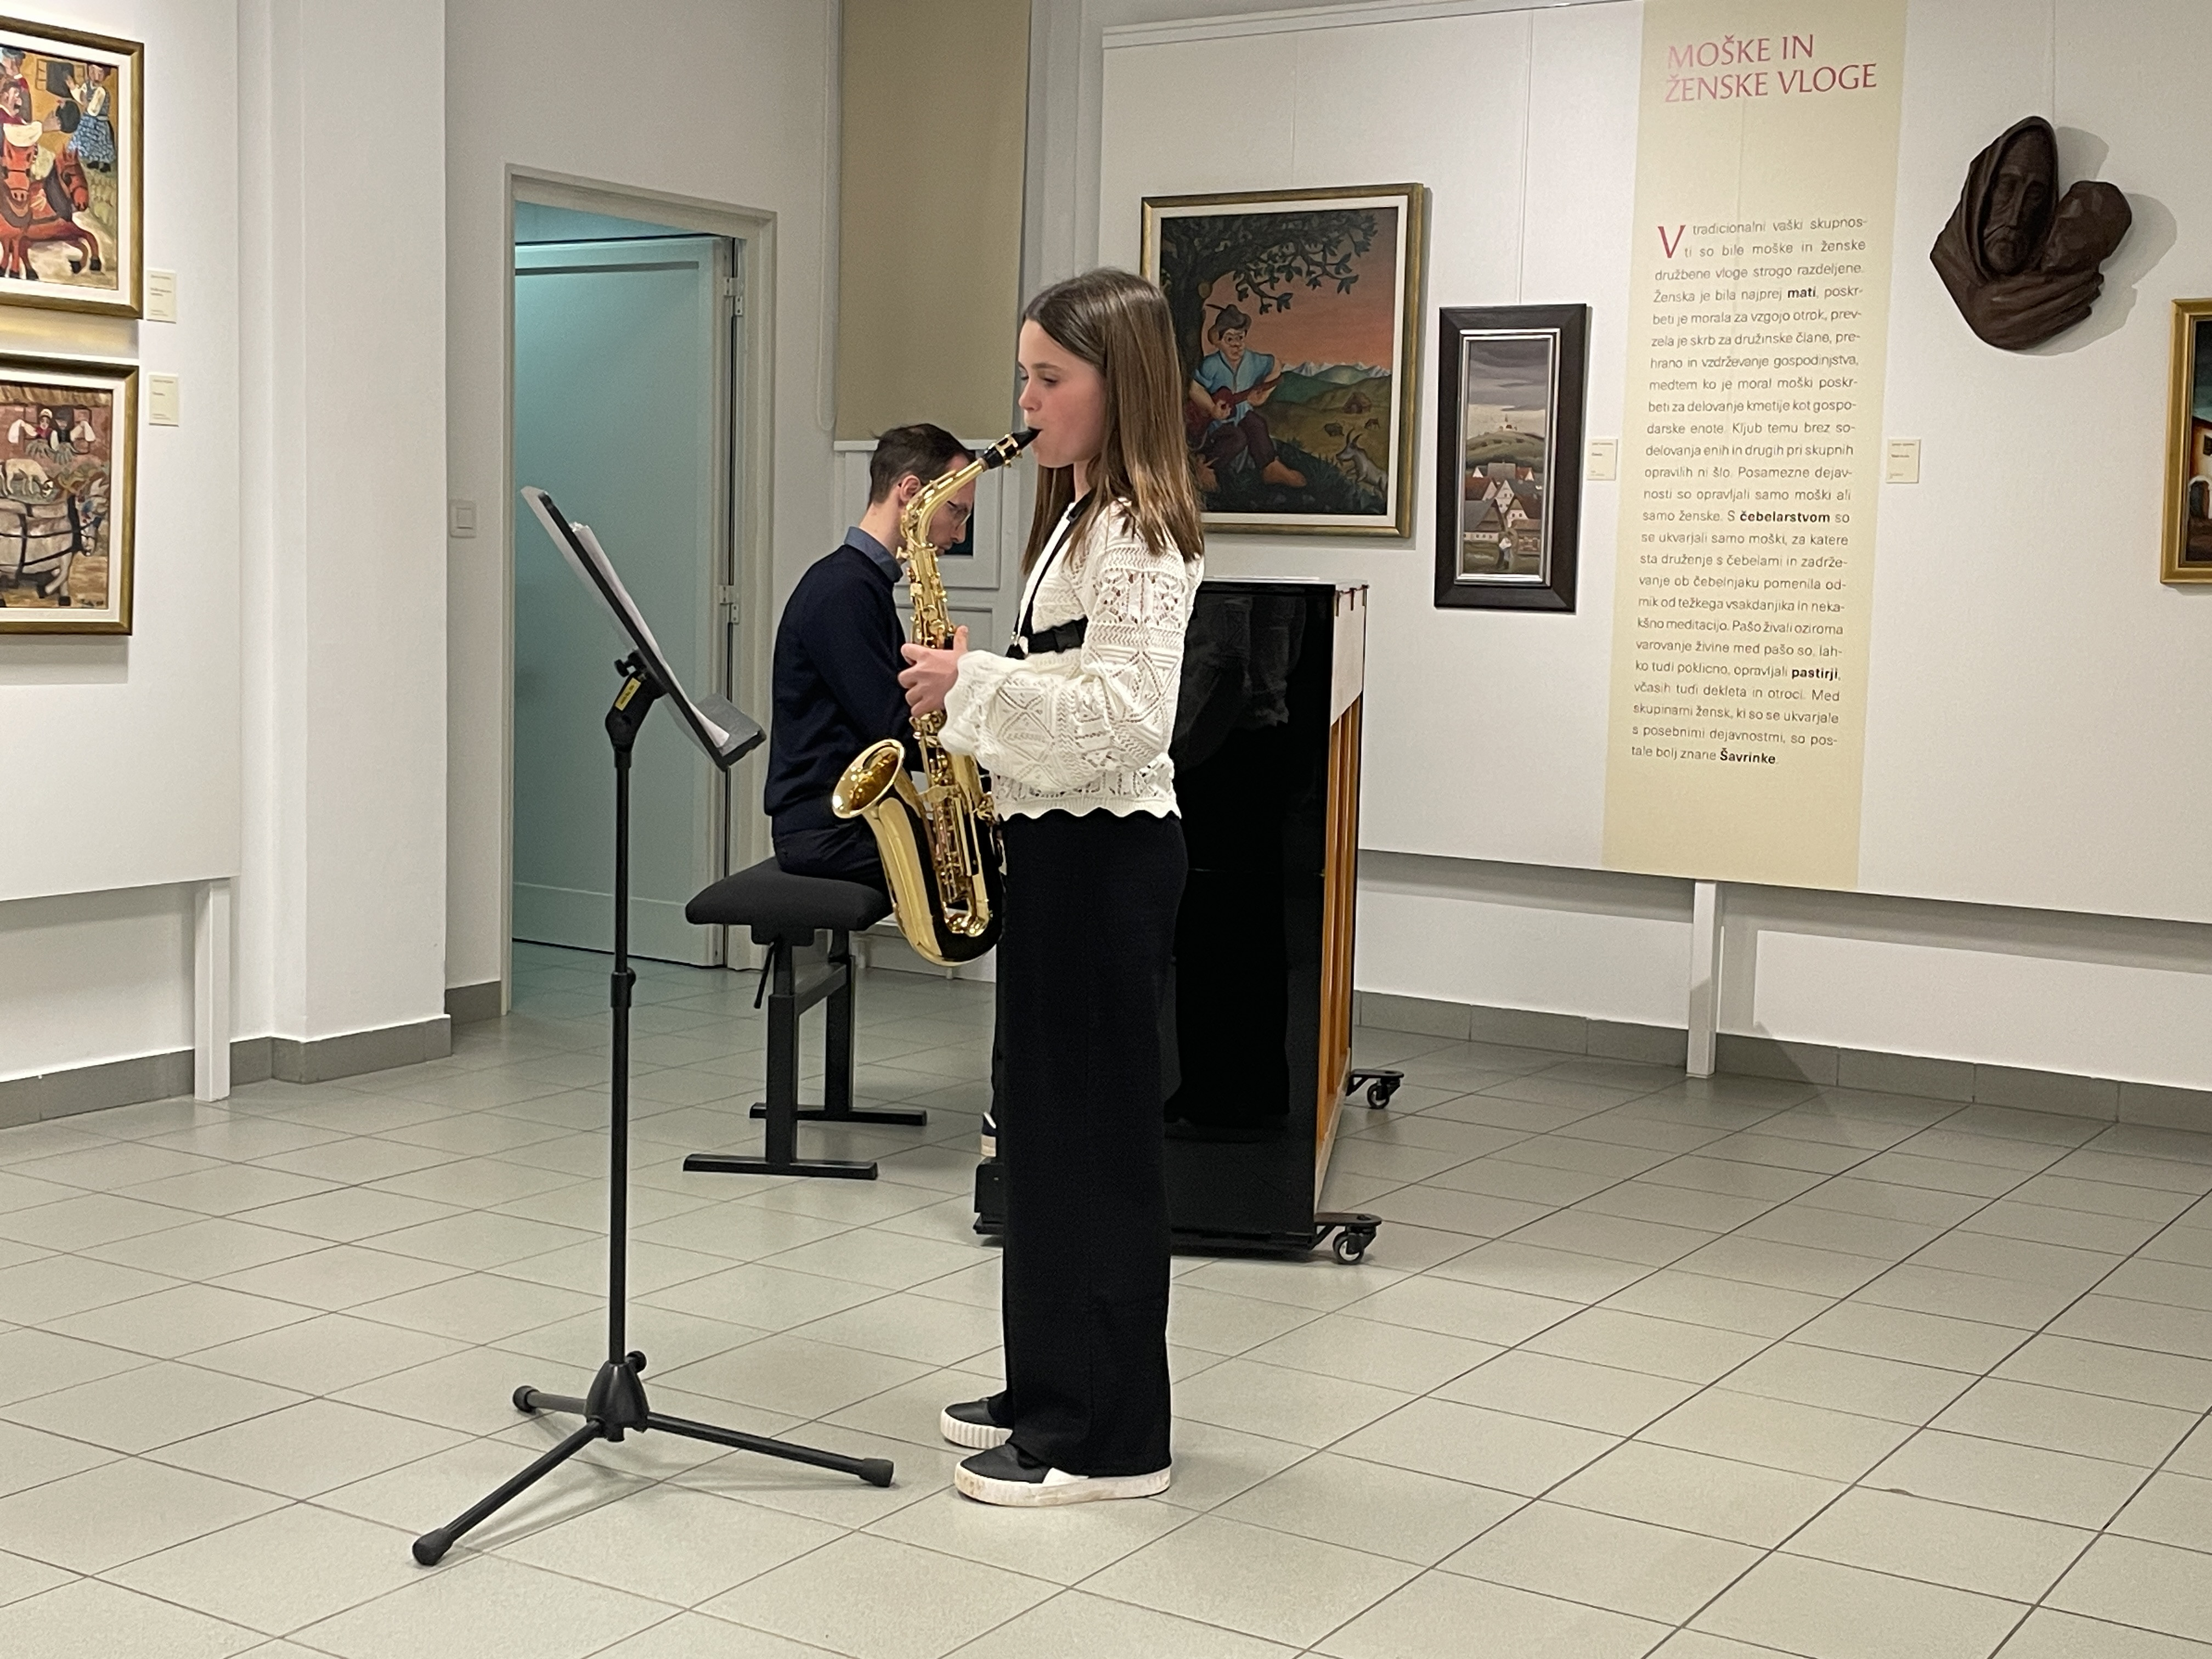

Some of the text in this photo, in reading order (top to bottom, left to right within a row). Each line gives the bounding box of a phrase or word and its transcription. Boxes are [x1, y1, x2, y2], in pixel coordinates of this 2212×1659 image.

[1667, 33, 1814, 67] MOŠKE IN
[1664, 63, 1878, 103] ŽENSKE VLOGE
[1657, 217, 1868, 259] V tradicionalni vaški skupnos-
[1684, 239, 1866, 258] ti so bile moške in ženske
[1655, 269, 1711, 281] družbene
[1715, 267, 1748, 281] vloge
[1753, 267, 1793, 279] strogo
[1652, 289, 1695, 303] Ženska
[1699, 292, 1711, 304] je
[1714, 289, 1736, 301] bila
[1740, 290, 1783, 302] najprej
[1824, 285, 1864, 300] poskr-
[1652, 308, 1862, 327] beti je morala za vzgojo otrok, prev-
[1651, 331, 1861, 349] zela je skrb za družinske člane, pre-
[1650, 354, 1859, 370] hrano in vzdrževanje gospodinjstva,
[1649, 376, 1859, 392] medtem ko je moral moški poskr-
[1647, 399, 1857, 414] beti za delovanje kmetije kot gospo-
[1646, 422, 1686, 435] darske
[1732, 422, 1763, 436] Kljub
[1767, 424, 1798, 434] temu
[1803, 421, 1831, 433] brez
[1835, 424, 1856, 433] so-
[1645, 444, 1854, 458] delovanja enih in drugih pri skupnih
[1644, 466, 1694, 480] opravilih
[1697, 469, 1708, 477] ni
[1737, 466, 1810, 478] Posamezne
[1814, 466, 1853, 481] dejav-
[1643, 488, 1852, 503] nosti so opravljali samo moški ali
[1642, 511, 1675, 521] samo
[1727, 510, 1736, 522] S
[1739, 510, 1831, 523] čebelarstvom
[1835, 514, 1850, 523] so
[1641, 532, 1849, 546] se ukvarjali samo moški, za katere
[1639, 553, 1849, 568] sta druženje s čebelami in zadrže-
[1639, 575, 1847, 591] vanje ob čebelnjaku pomenila od-
[1638, 595, 1846, 613] mik od težkega vsakdanjika in neka-
[1637, 617, 1664, 629] kšno
[1732, 620, 1762, 633] Pašo
[1763, 621, 1793, 633] živali
[1794, 624, 1844, 635] oziroma
[1635, 641, 1692, 653] varovanje
[1694, 640, 1730, 653] živine
[1733, 643, 1760, 654] med
[1764, 644, 1795, 657] pašo
[1819, 645, 1843, 657] lah-
[1635, 659, 1649, 672] ko
[1651, 661, 1674, 672] tudi
[1733, 665, 1788, 679] opravljali
[1791, 667, 1842, 682] pastirji,
[1633, 681, 1671, 693] včasih
[1675, 684, 1699, 695] tudi
[1702, 684, 1747, 697] dekleta
[1752, 689, 1763, 698] in
[1811, 689, 1840, 702] Med
[1633, 703, 1694, 716] skupinami
[1736, 707, 1746, 719] ki
[1748, 710, 1764, 720] so
[1765, 712, 1781, 721] se
[1783, 710, 1839, 725] ukvarjale
[1632, 726, 1838, 747] s posebnimi dejavnostmi, so pos-
[1631, 745, 1654, 757] tale
[1655, 747, 1678, 760] bolj
[1680, 750, 1717, 761] znane
